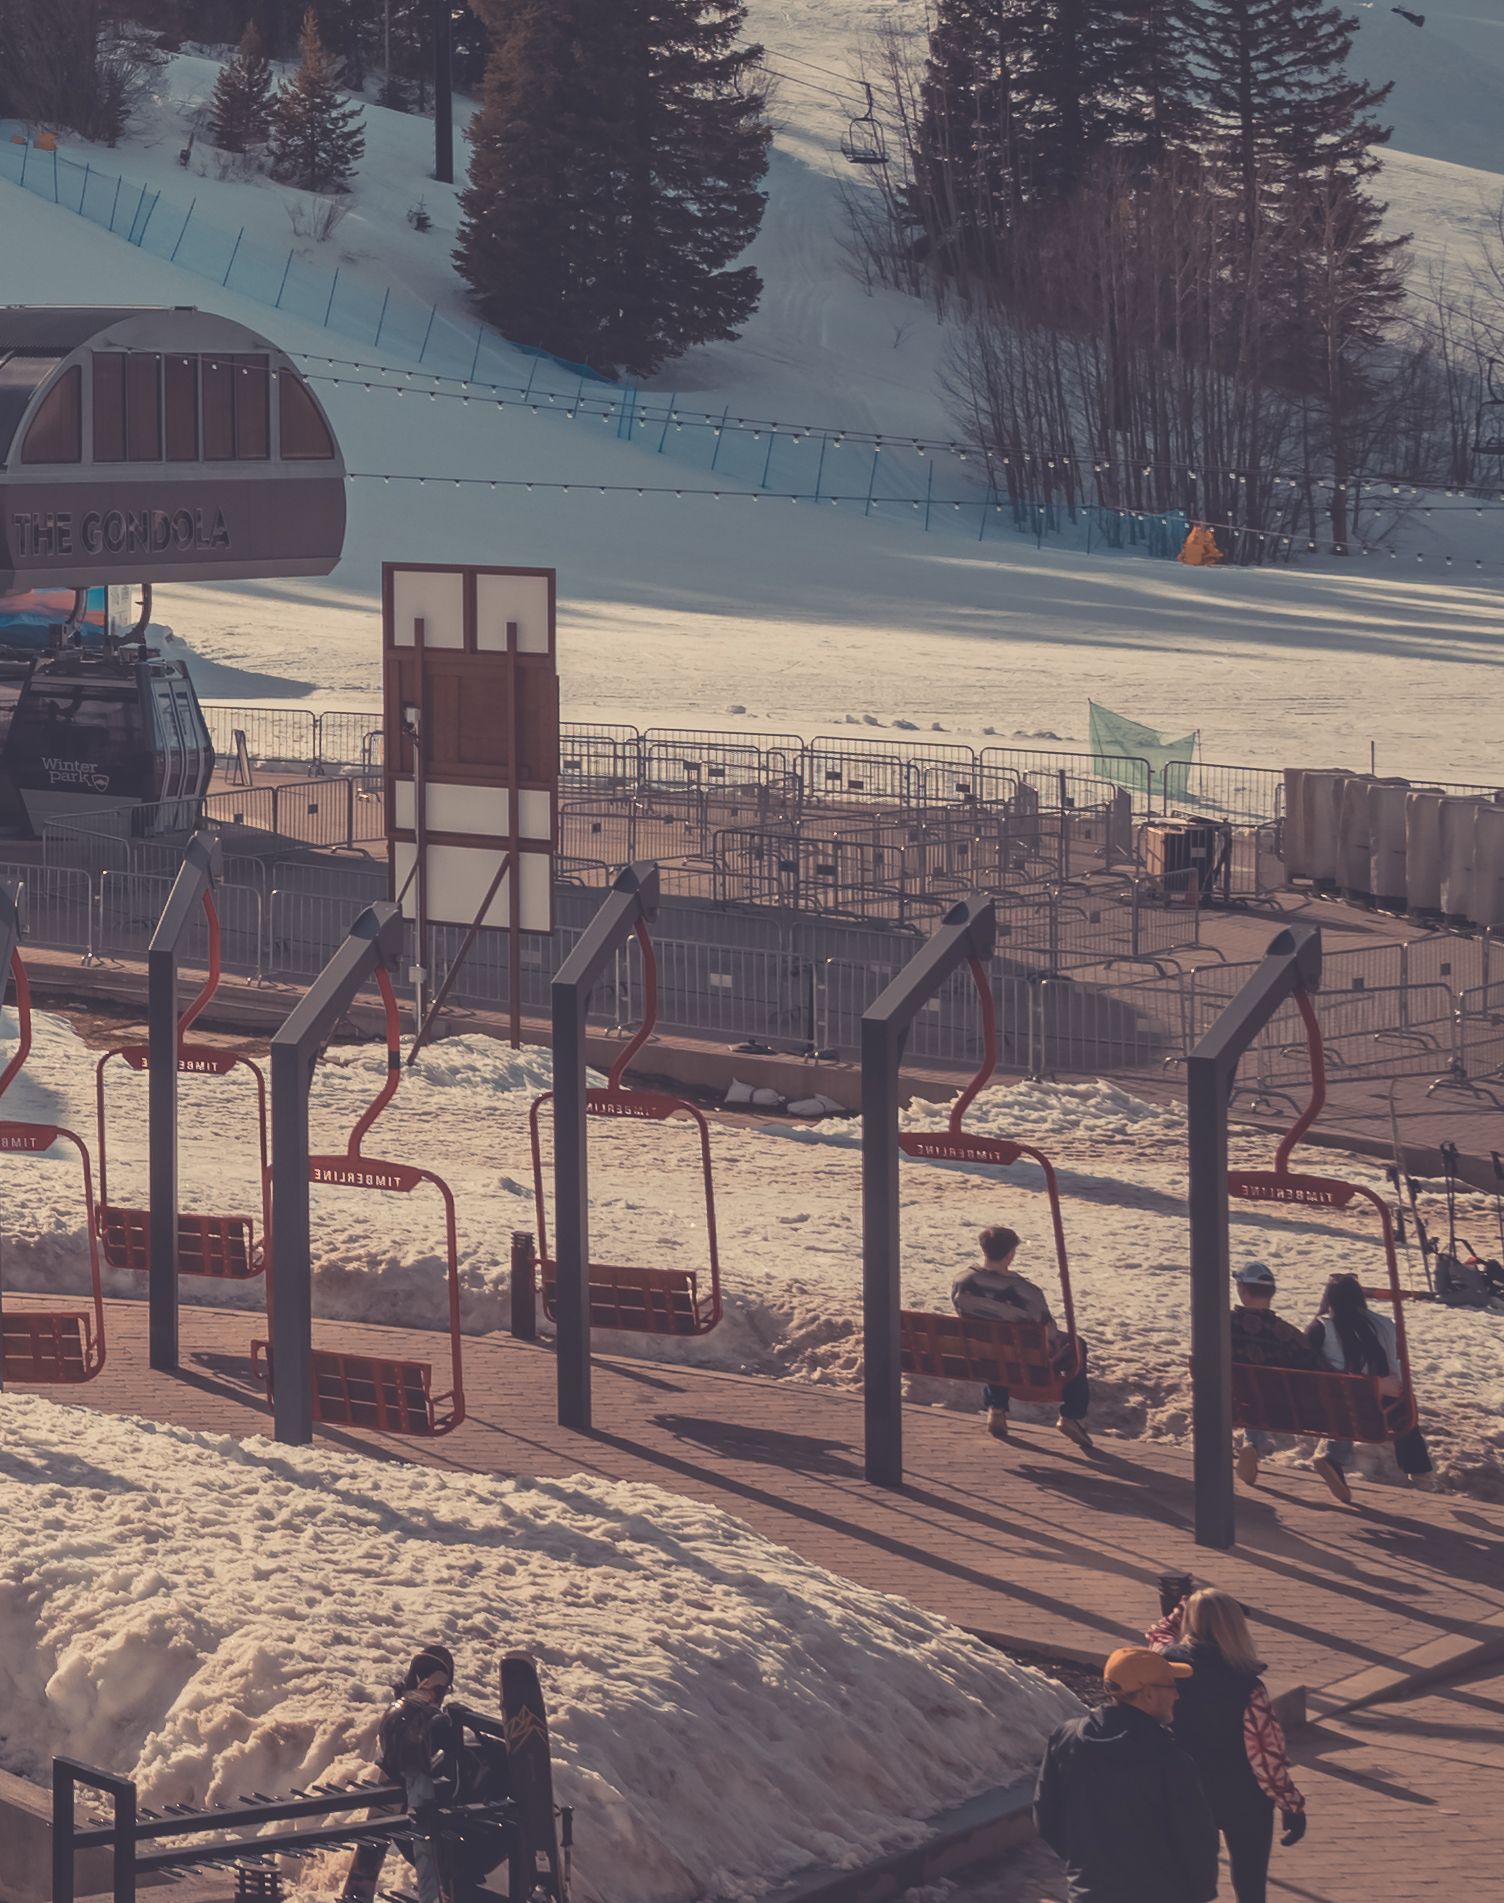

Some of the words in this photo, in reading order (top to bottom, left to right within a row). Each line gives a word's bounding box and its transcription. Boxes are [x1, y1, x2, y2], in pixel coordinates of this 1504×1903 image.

[13, 511, 73, 557] THE
[81, 507, 231, 554] GONDOLA
[41, 757, 98, 773] Winter
